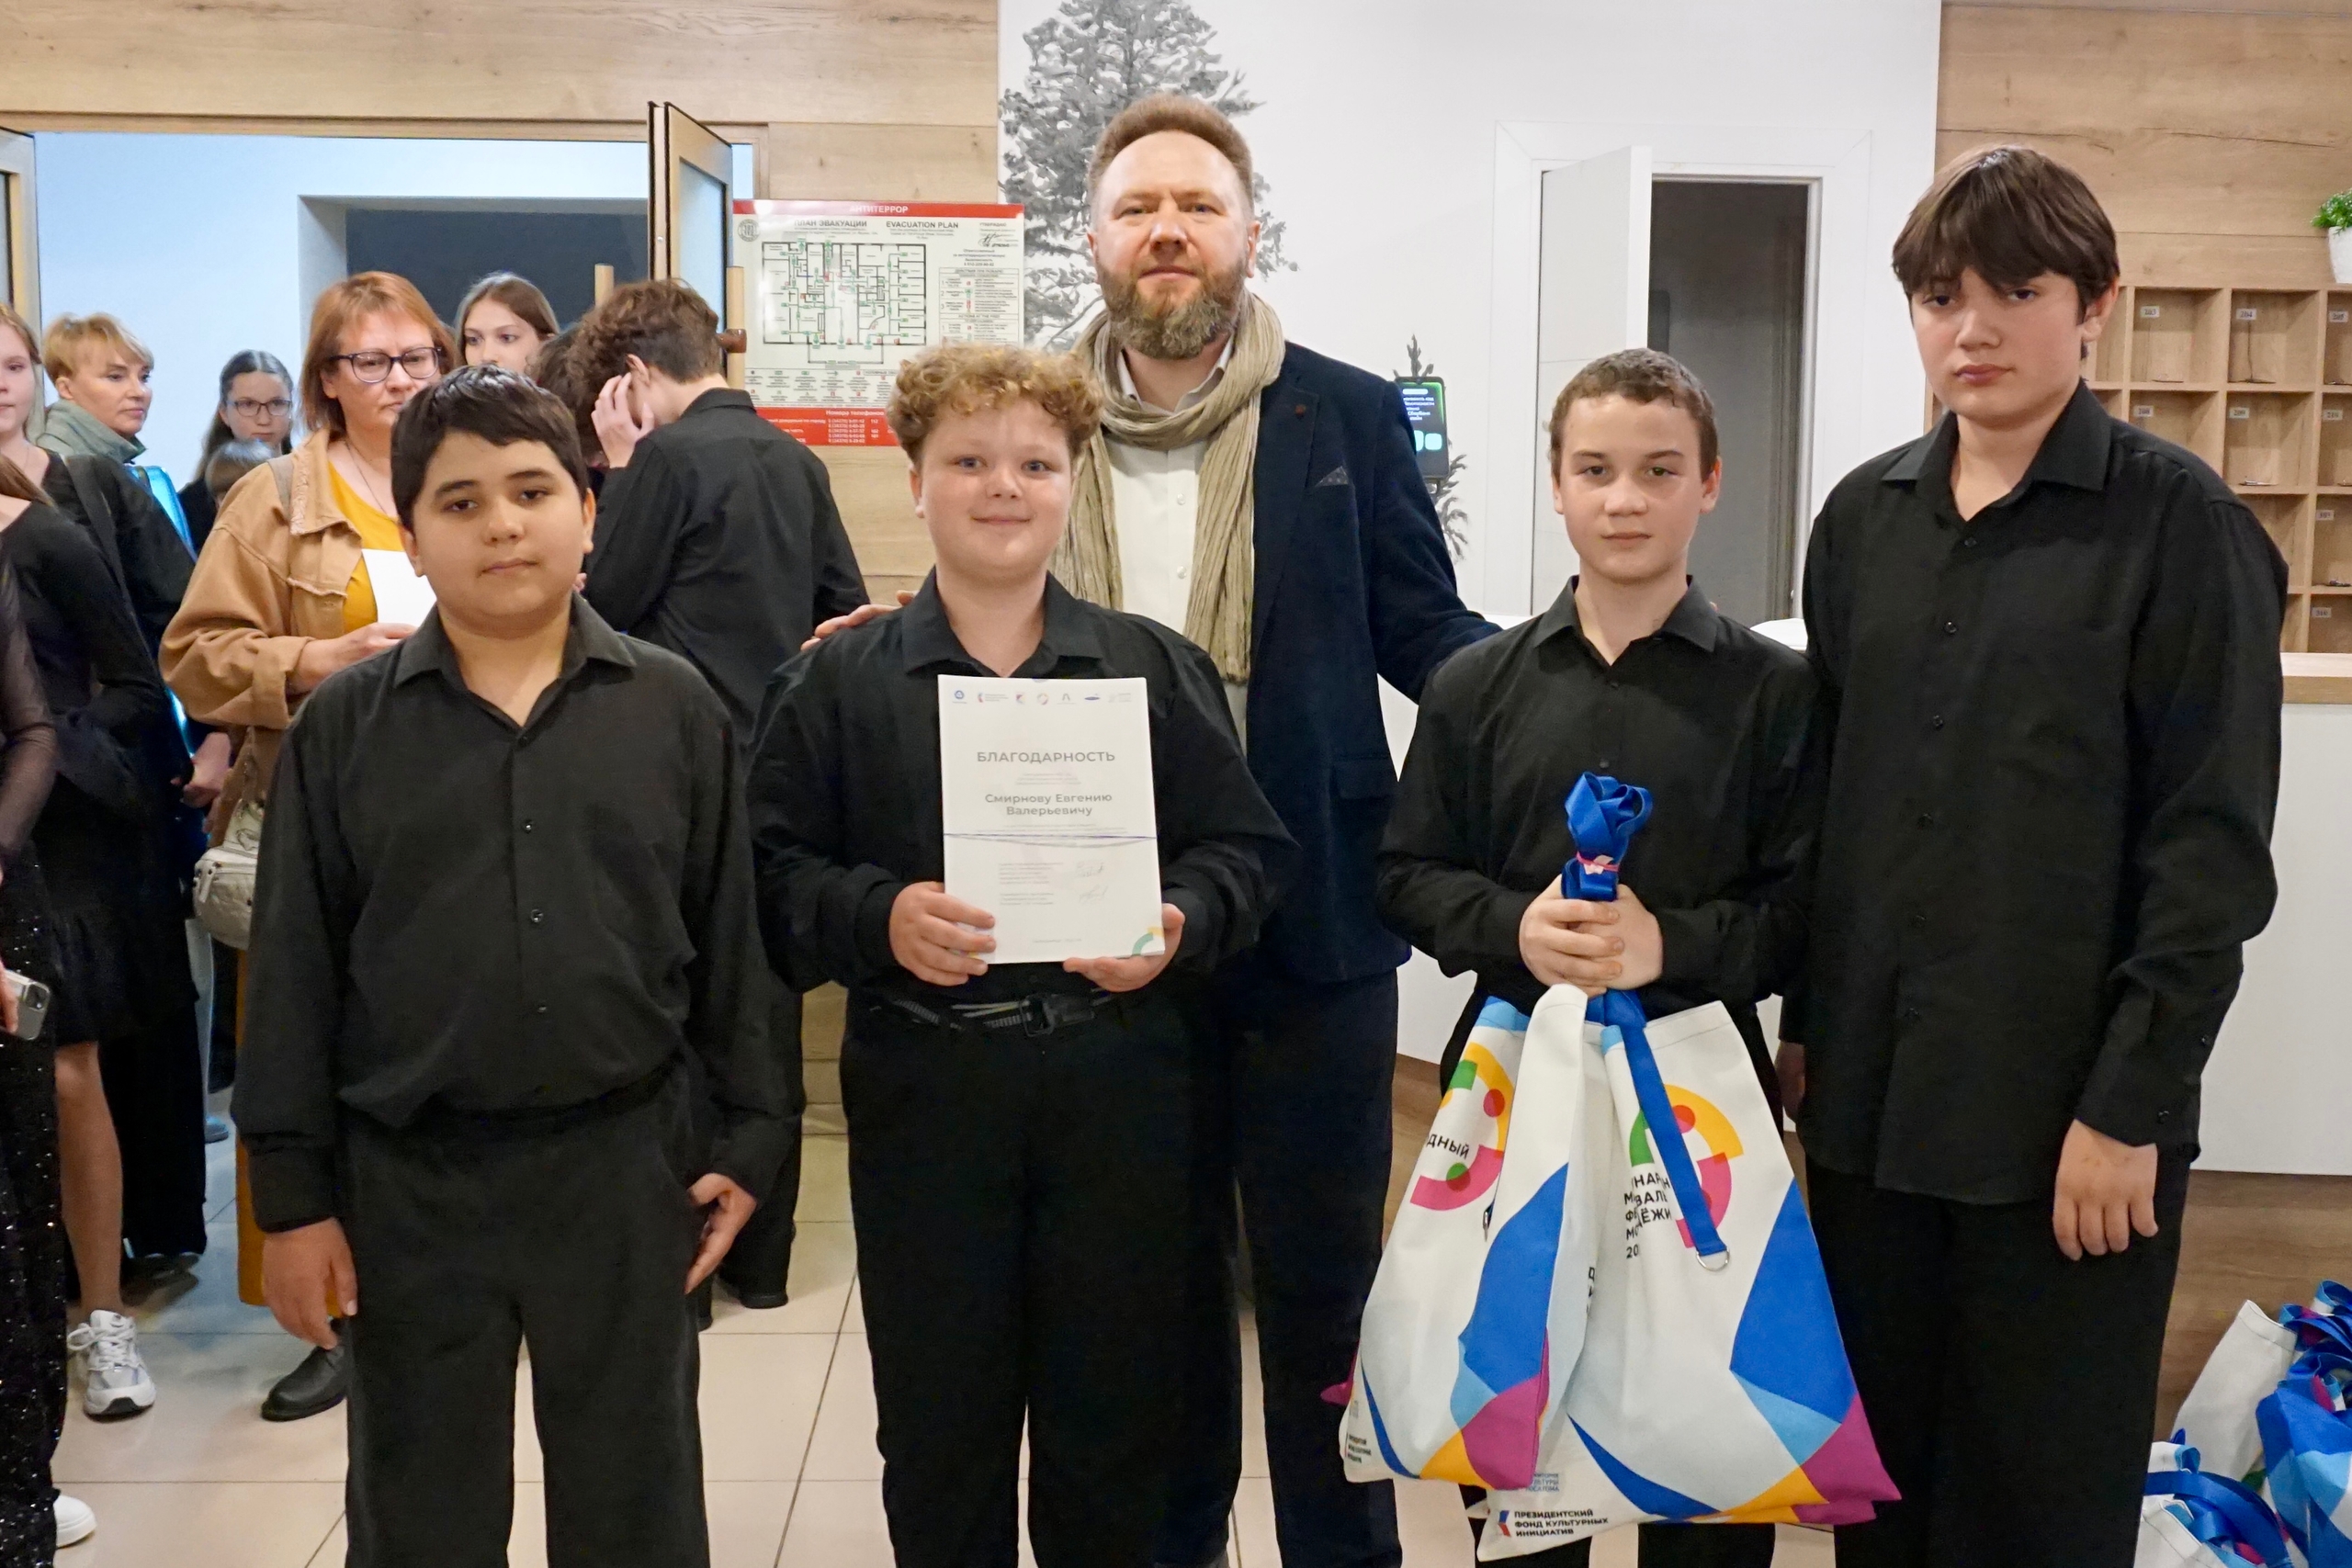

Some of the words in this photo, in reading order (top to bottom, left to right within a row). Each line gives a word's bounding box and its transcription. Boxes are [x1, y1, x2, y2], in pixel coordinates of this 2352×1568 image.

[849, 205, 909, 213] АНТИТЕРРОР
[819, 220, 867, 228] ЭВАКУАЦИИ
[886, 220, 935, 229] EVACUATION
[977, 751, 1115, 763] БЛАГОДАРНОСТЬ
[985, 794, 1052, 805] Смирнову
[1056, 794, 1113, 803] Евгению
[1006, 806, 1092, 817] Валерьевичу
[1514, 1508, 1594, 1518] ПРЕЗИДЕНТСКИЙ
[1545, 1517, 1609, 1528] КУЛЬТУРНЫХ
[1516, 1529, 1574, 1538] ИНИЦИАТИВ
